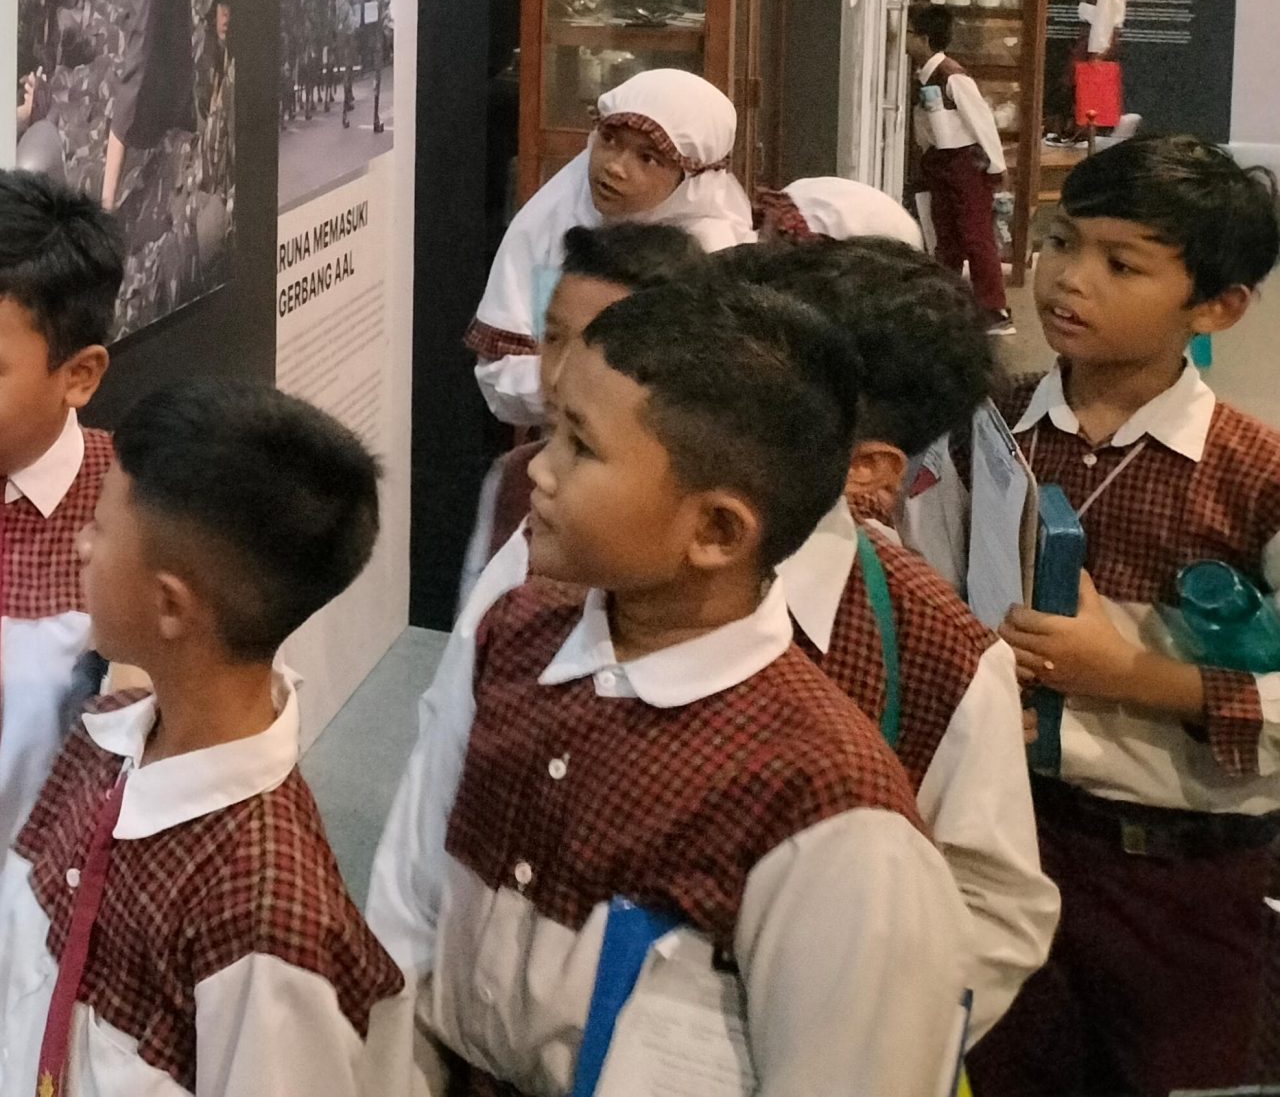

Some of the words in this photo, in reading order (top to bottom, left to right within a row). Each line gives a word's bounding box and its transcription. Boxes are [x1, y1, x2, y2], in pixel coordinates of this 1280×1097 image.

[278, 232, 311, 273] RUNA
[313, 200, 369, 254] MEMASUKI
[278, 263, 332, 318] GERBANG
[334, 250, 355, 285] AAL
